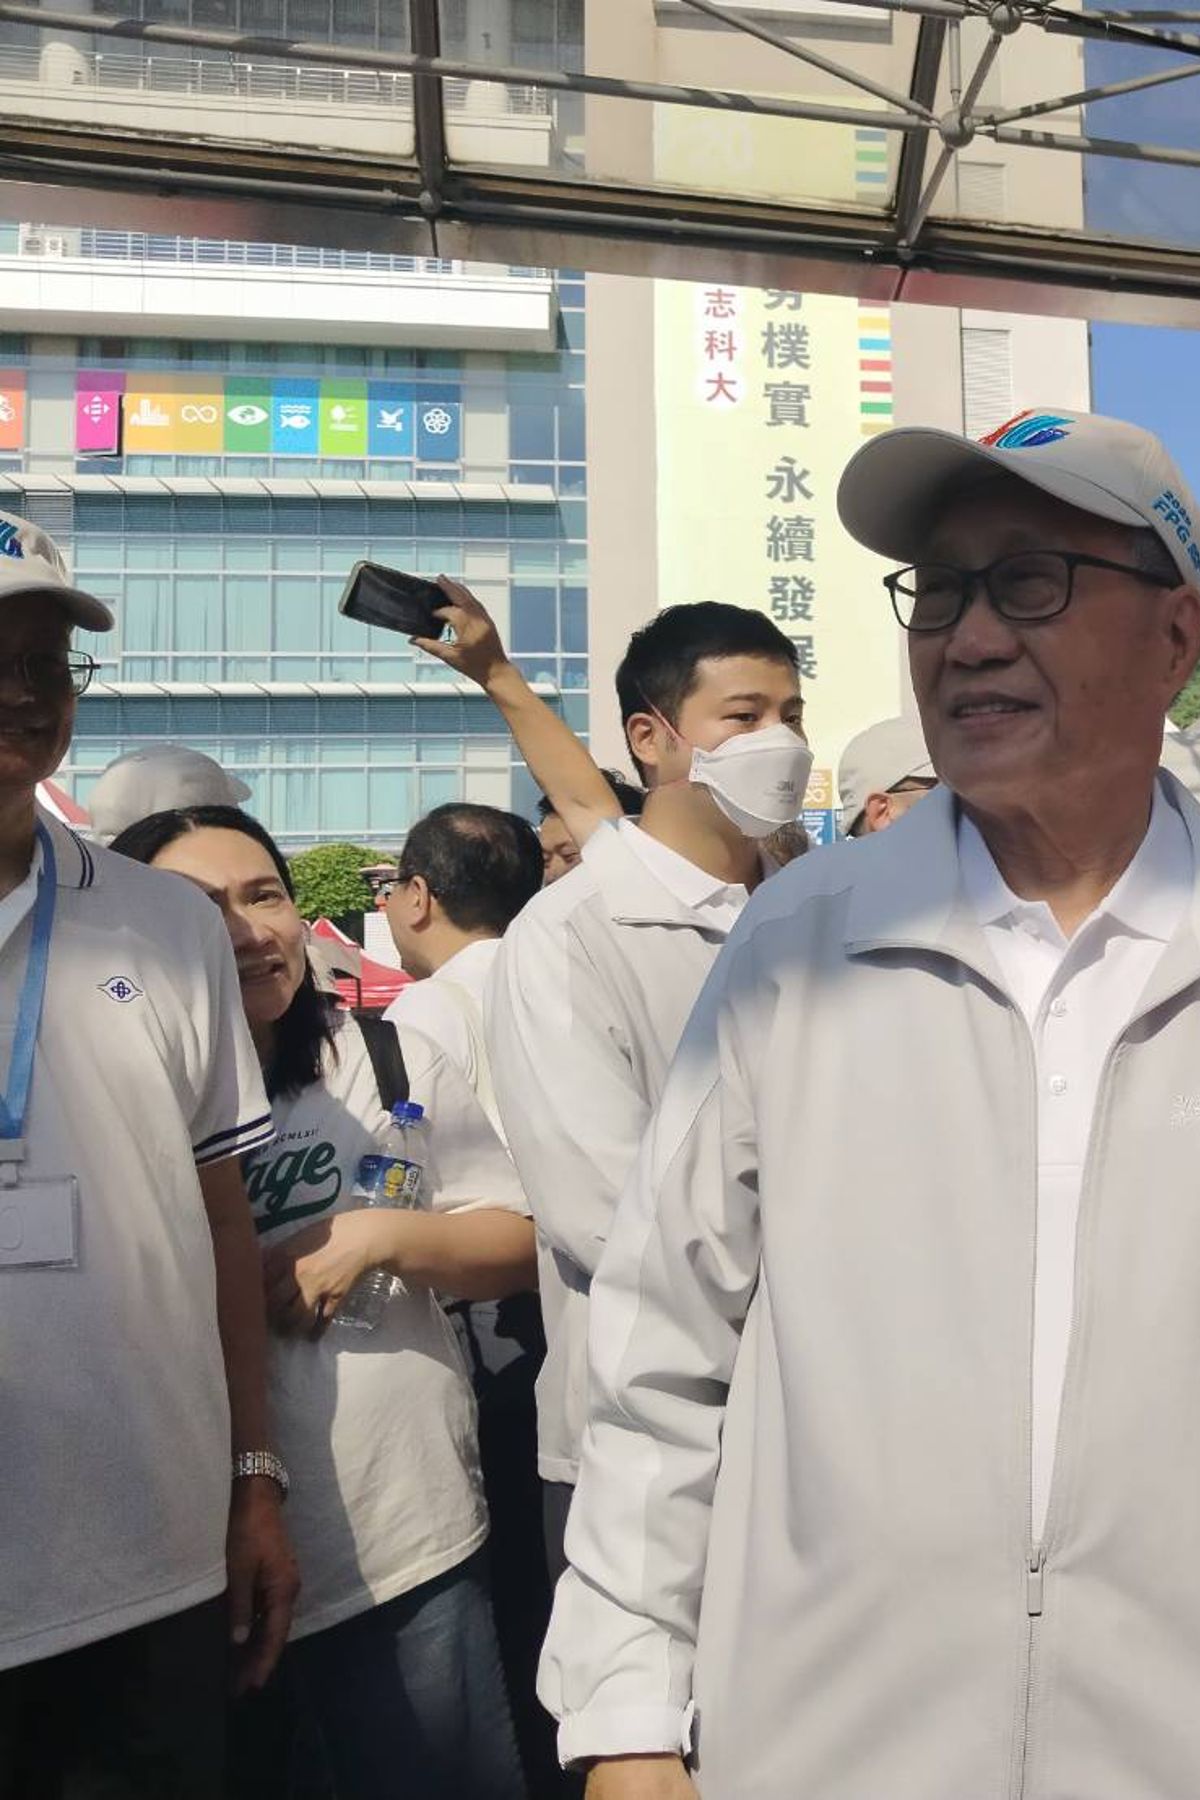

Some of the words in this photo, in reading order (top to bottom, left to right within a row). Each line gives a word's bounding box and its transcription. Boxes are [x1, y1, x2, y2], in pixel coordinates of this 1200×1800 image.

[704, 287, 737, 403] 志科大
[1152, 500, 1190, 544] FPG
